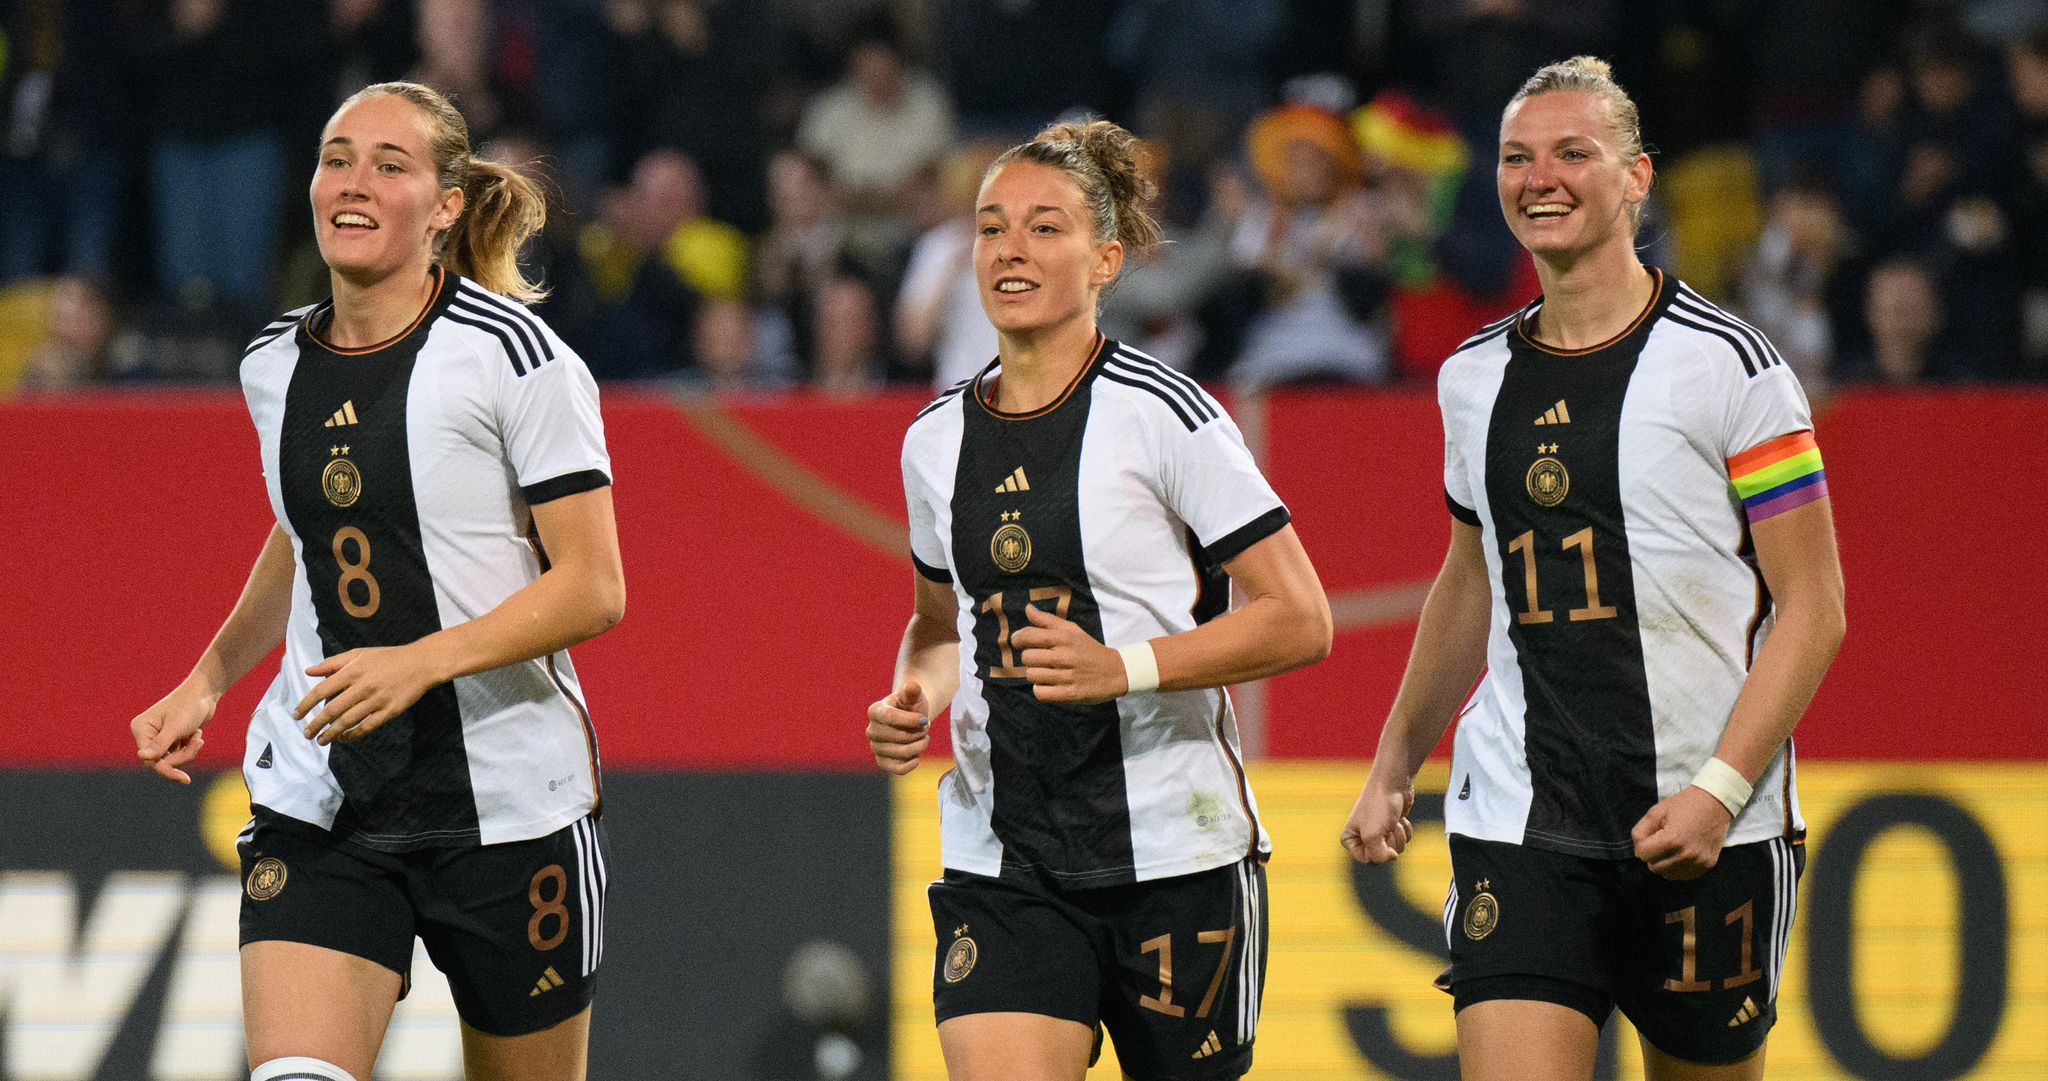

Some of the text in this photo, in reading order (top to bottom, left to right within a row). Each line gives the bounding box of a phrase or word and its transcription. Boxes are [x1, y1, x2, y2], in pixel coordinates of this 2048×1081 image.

[332, 526, 380, 618] 8
[1508, 526, 1617, 624] 11
[528, 864, 569, 951] 8
[1664, 899, 1762, 992] 11
[1139, 926, 1235, 1018] 17
